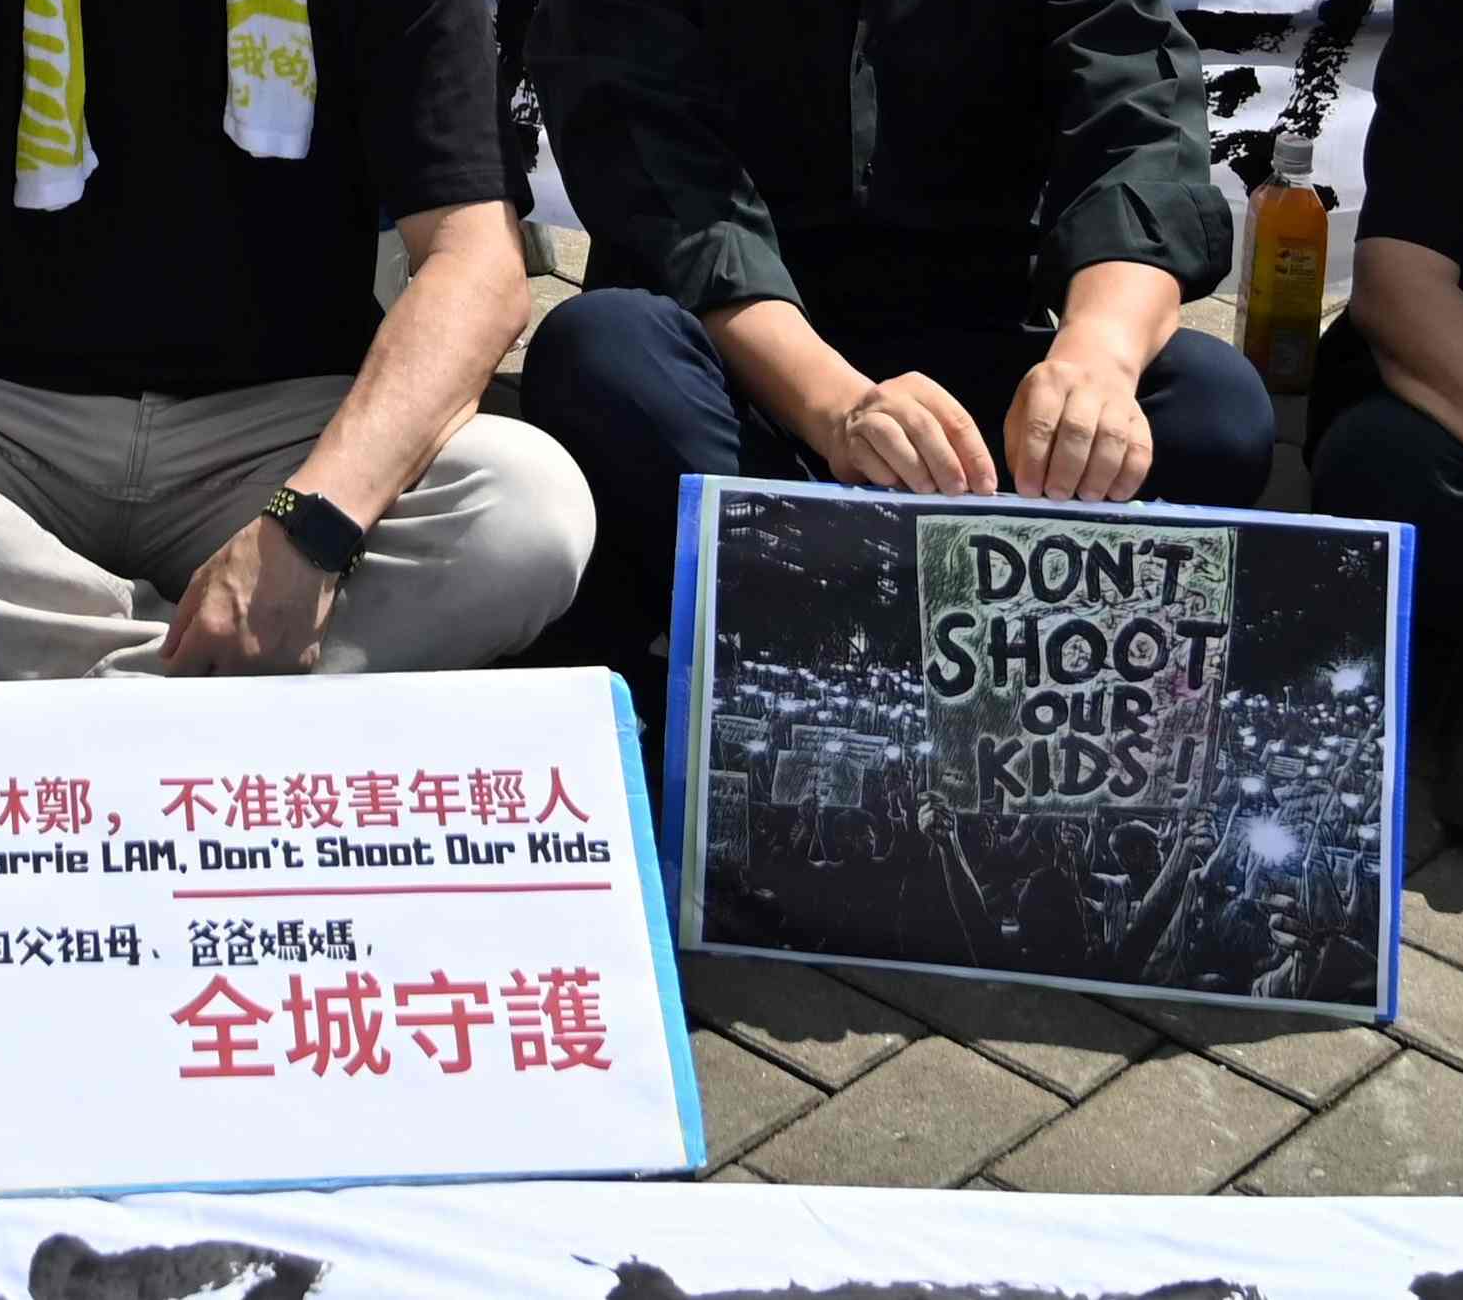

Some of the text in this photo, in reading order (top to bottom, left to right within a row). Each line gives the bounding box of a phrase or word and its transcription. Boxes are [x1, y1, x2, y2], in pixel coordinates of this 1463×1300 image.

[969, 534, 1194, 606] DON'T
[925, 613, 1229, 698] SHOOT
[1020, 685, 1156, 736] OUR
[103, 842, 186, 873] LAM,
[200, 841, 303, 869] Don't
[317, 838, 433, 866] Shoot
[446, 836, 515, 864] Our
[529, 834, 610, 862] Kids
[171, 967, 612, 1080] 全城守護
